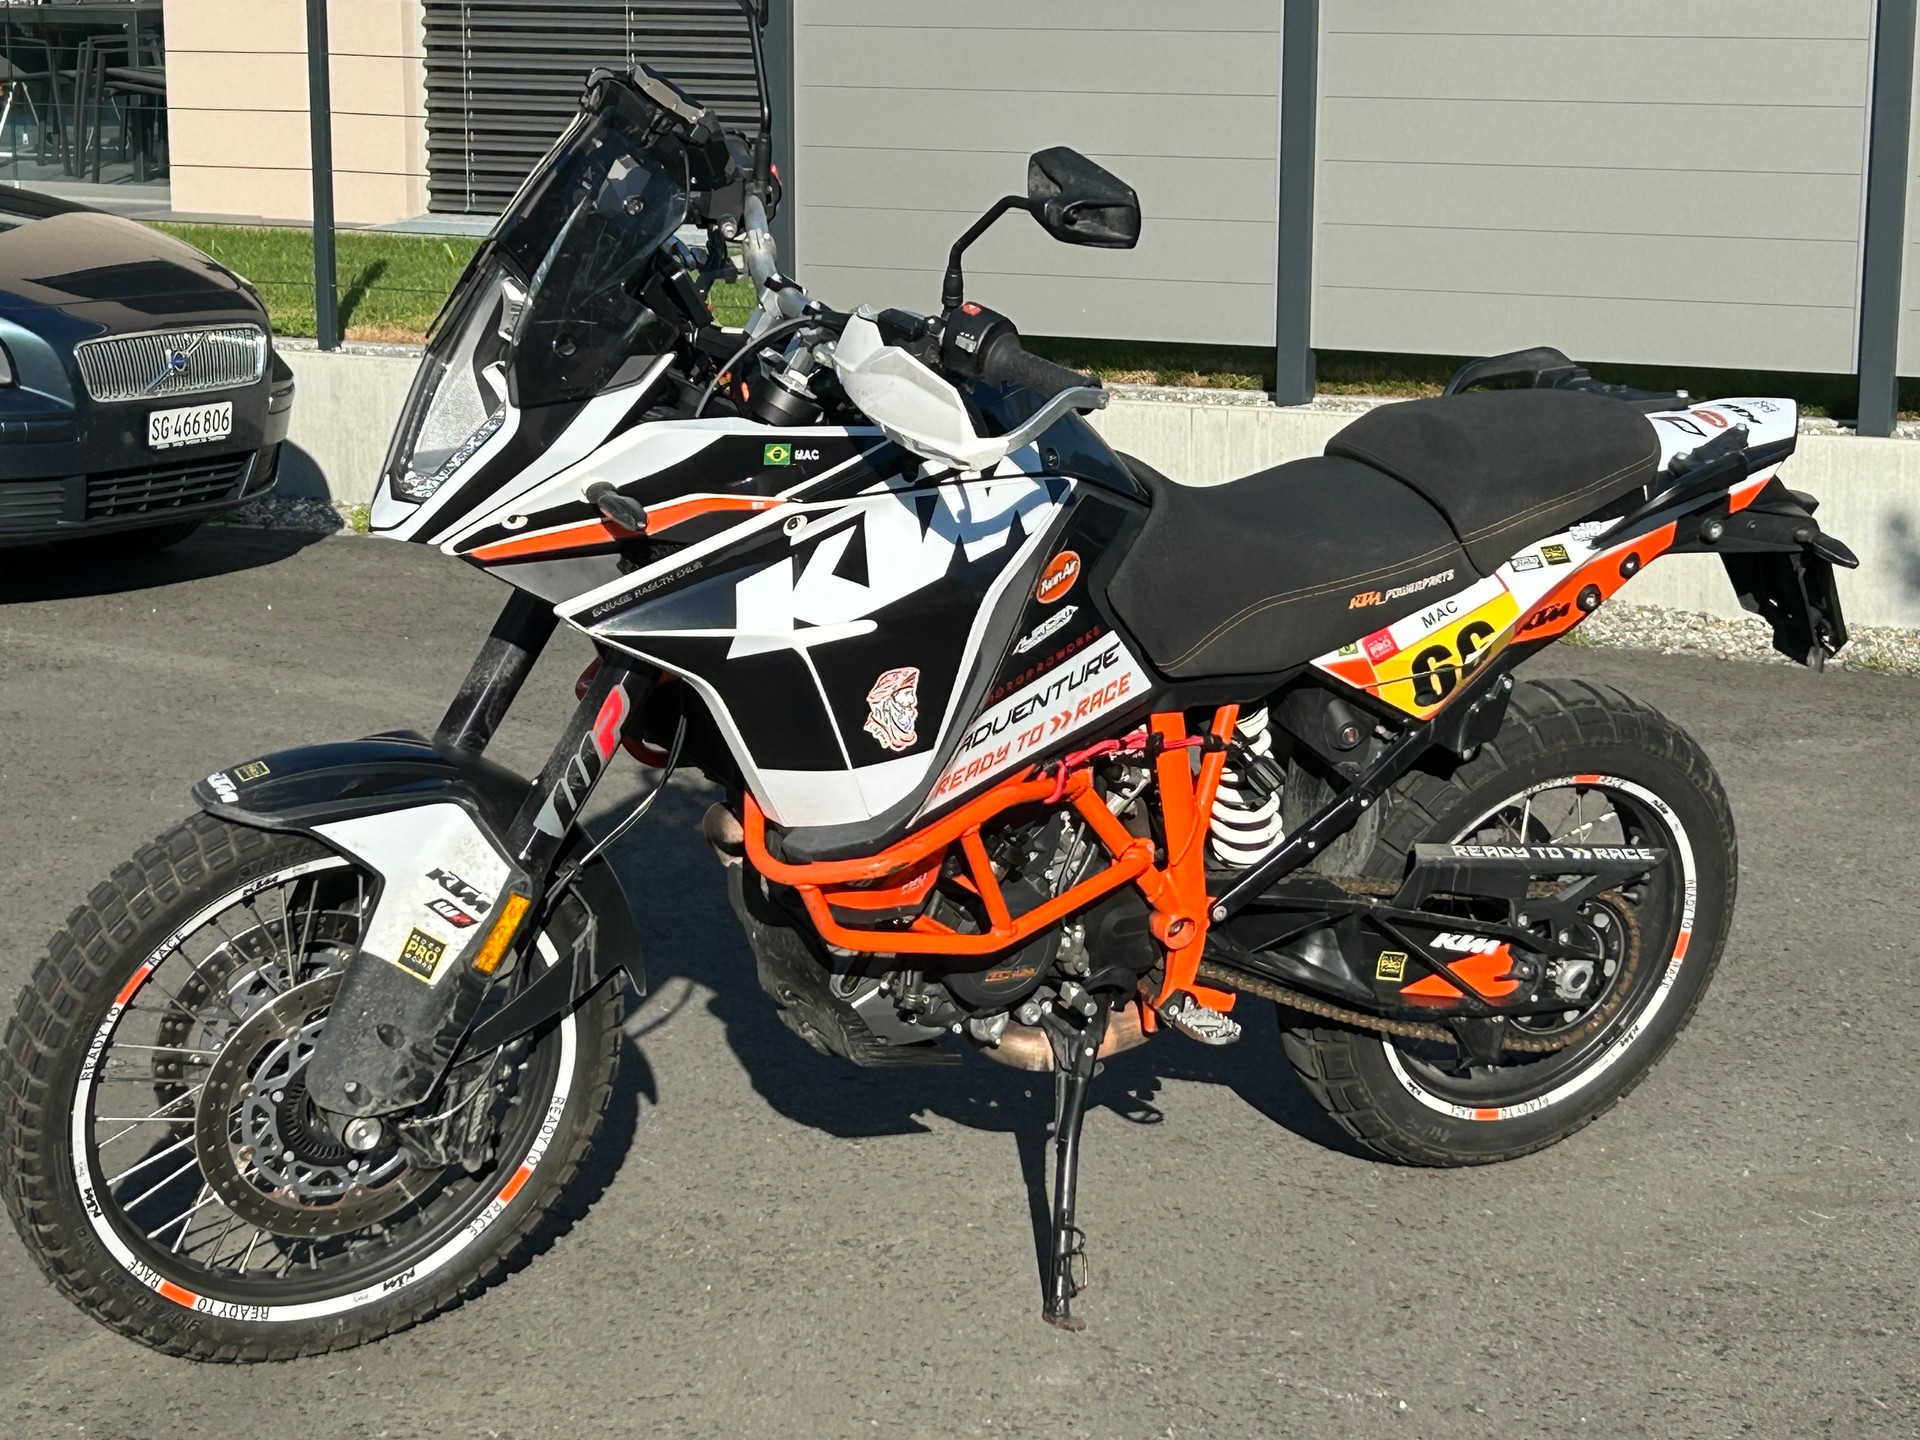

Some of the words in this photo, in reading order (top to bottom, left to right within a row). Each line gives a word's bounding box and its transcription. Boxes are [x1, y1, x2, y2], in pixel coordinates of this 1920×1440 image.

[795, 449, 820, 460] MAC
[1349, 590, 1384, 609] KTM
[1421, 601, 1458, 628] MAC
[958, 641, 1121, 753] ADVENTURE
[934, 741, 1012, 797] READY
[1016, 721, 1046, 752] TO
[1073, 671, 1132, 722] RACE
[1451, 845, 1530, 858] READY
[1531, 846, 1565, 859] TO
[1594, 848, 1656, 861] RACE
[425, 872, 492, 915] KTM
[405, 940, 438, 964] PRO
[1429, 932, 1501, 956] KTM
[538, 1095, 567, 1145] READY
[465, 1200, 504, 1237] RACE
[126, 1258, 164, 1289] RACE
[197, 1298, 216, 1315] TO
[217, 1304, 270, 1321] READY
